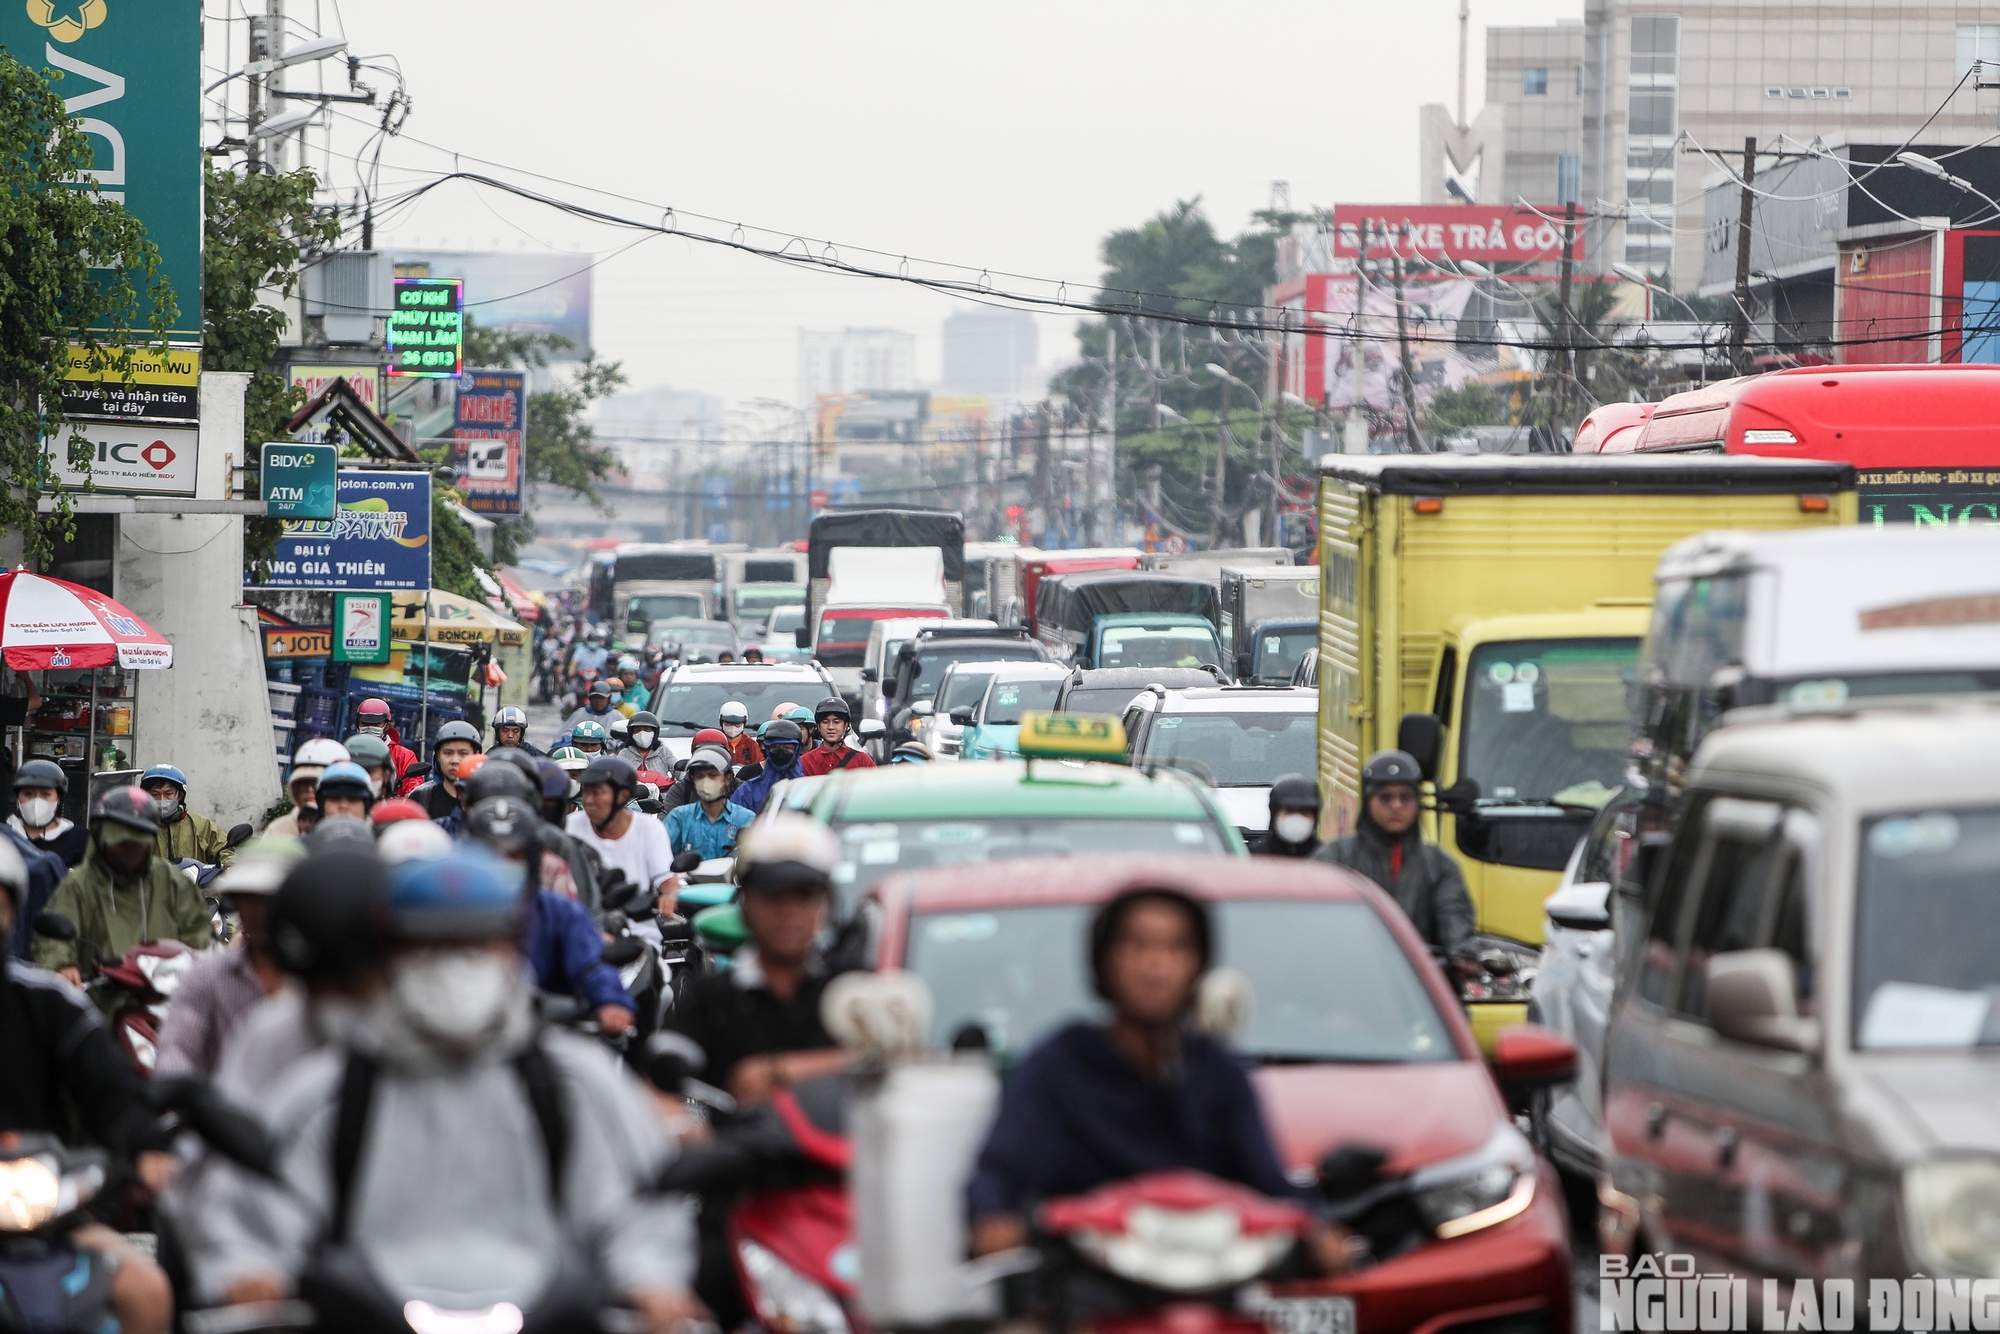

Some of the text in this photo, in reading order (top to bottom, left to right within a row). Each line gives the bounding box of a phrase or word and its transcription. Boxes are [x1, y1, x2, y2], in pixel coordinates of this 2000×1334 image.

[1406, 224, 1445, 249] XE
[1451, 218, 1508, 249] TRẢ
[422, 289, 449, 306] KHÍ
[167, 362, 191, 374] WU
[111, 389, 125, 400] và
[128, 391, 159, 404] nhận
[162, 391, 187, 403] tiền
[103, 402, 145, 415] tại đây
[459, 390, 517, 429] NGHỆ
[270, 454, 302, 467] BIDV
[1868, 473, 1883, 484] XE
[1884, 470, 1911, 484] MIỀN
[1912, 471, 1942, 484] ĐÔNG
[1947, 470, 1969, 483] BẾN
[1970, 472, 1984, 483] XE
[270, 487, 304, 500] ATM
[359, 512, 406, 520] 9001:2015
[294, 544, 331, 557] ĐẠI LÝ
[302, 561, 331, 574] GIA
[336, 559, 386, 575] THIÊN
[104, 617, 146, 636] OMO
[438, 629, 483, 641] BONCHA
[52, 656, 70, 666] OMO
